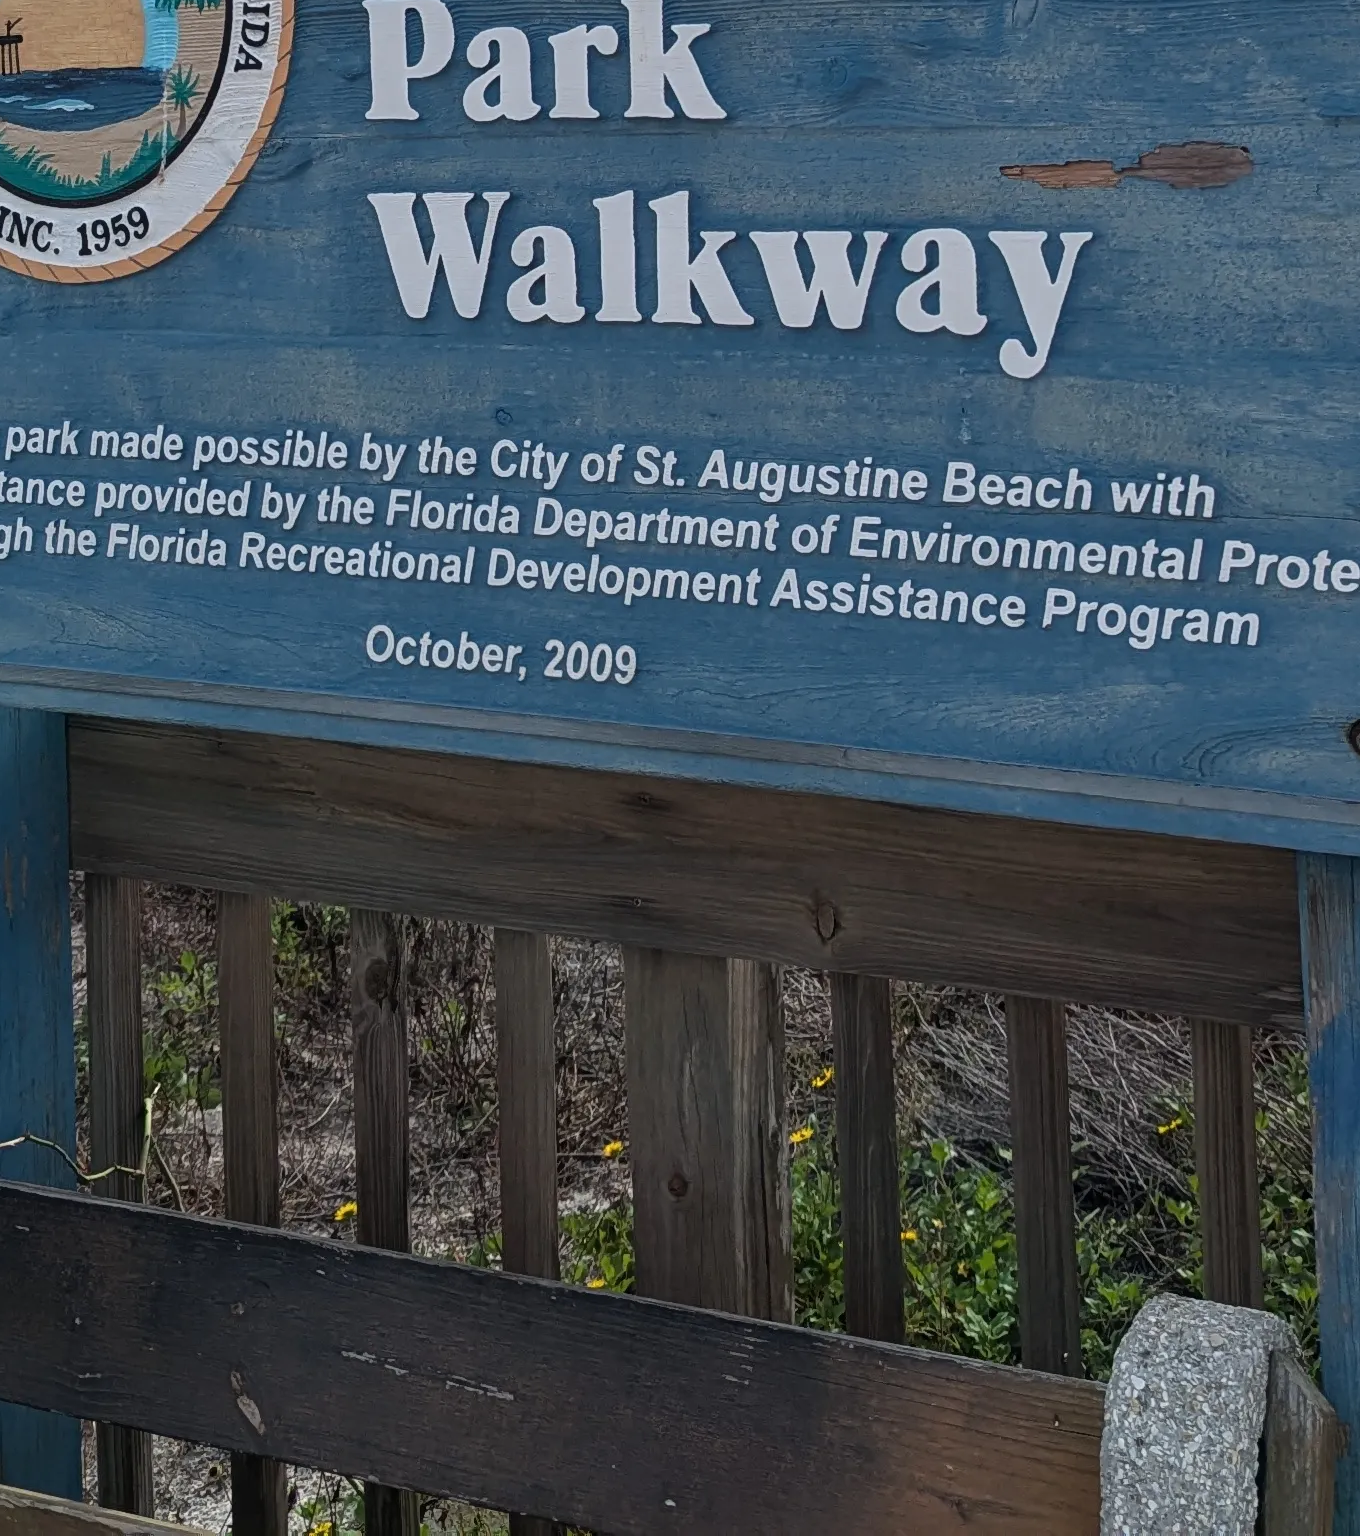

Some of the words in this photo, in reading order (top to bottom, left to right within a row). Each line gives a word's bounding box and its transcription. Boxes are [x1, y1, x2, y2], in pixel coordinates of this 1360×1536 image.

[77, 206, 149, 256] 1959
[366, 189, 1094, 379] Walkway
[4, 420, 79, 461] park
[89, 424, 184, 461] made
[192, 429, 348, 471] possible
[359, 432, 407, 482] by
[417, 435, 477, 476] the
[490, 438, 570, 490] City
[580, 443, 626, 483] of
[633, 445, 685, 487] St.
[697, 449, 928, 503] Augustine
[942, 461, 1092, 511] Beach
[1110, 472, 1215, 518] with
[94, 476, 252, 517] provided
[260, 481, 307, 530] by
[317, 485, 375, 525] the
[385, 488, 520, 534] Florida
[533, 496, 780, 552] Department
[791, 514, 841, 554] of
[849, 515, 1204, 582] Environmental
[44, 519, 97, 557] the
[106, 522, 227, 567] Florida
[239, 531, 476, 584] Recreational
[487, 547, 762, 606] Development
[769, 568, 1026, 628] Assistance
[1042, 587, 1260, 650] Program
[365, 624, 527, 682] October,
[543, 639, 637, 685] 2009
